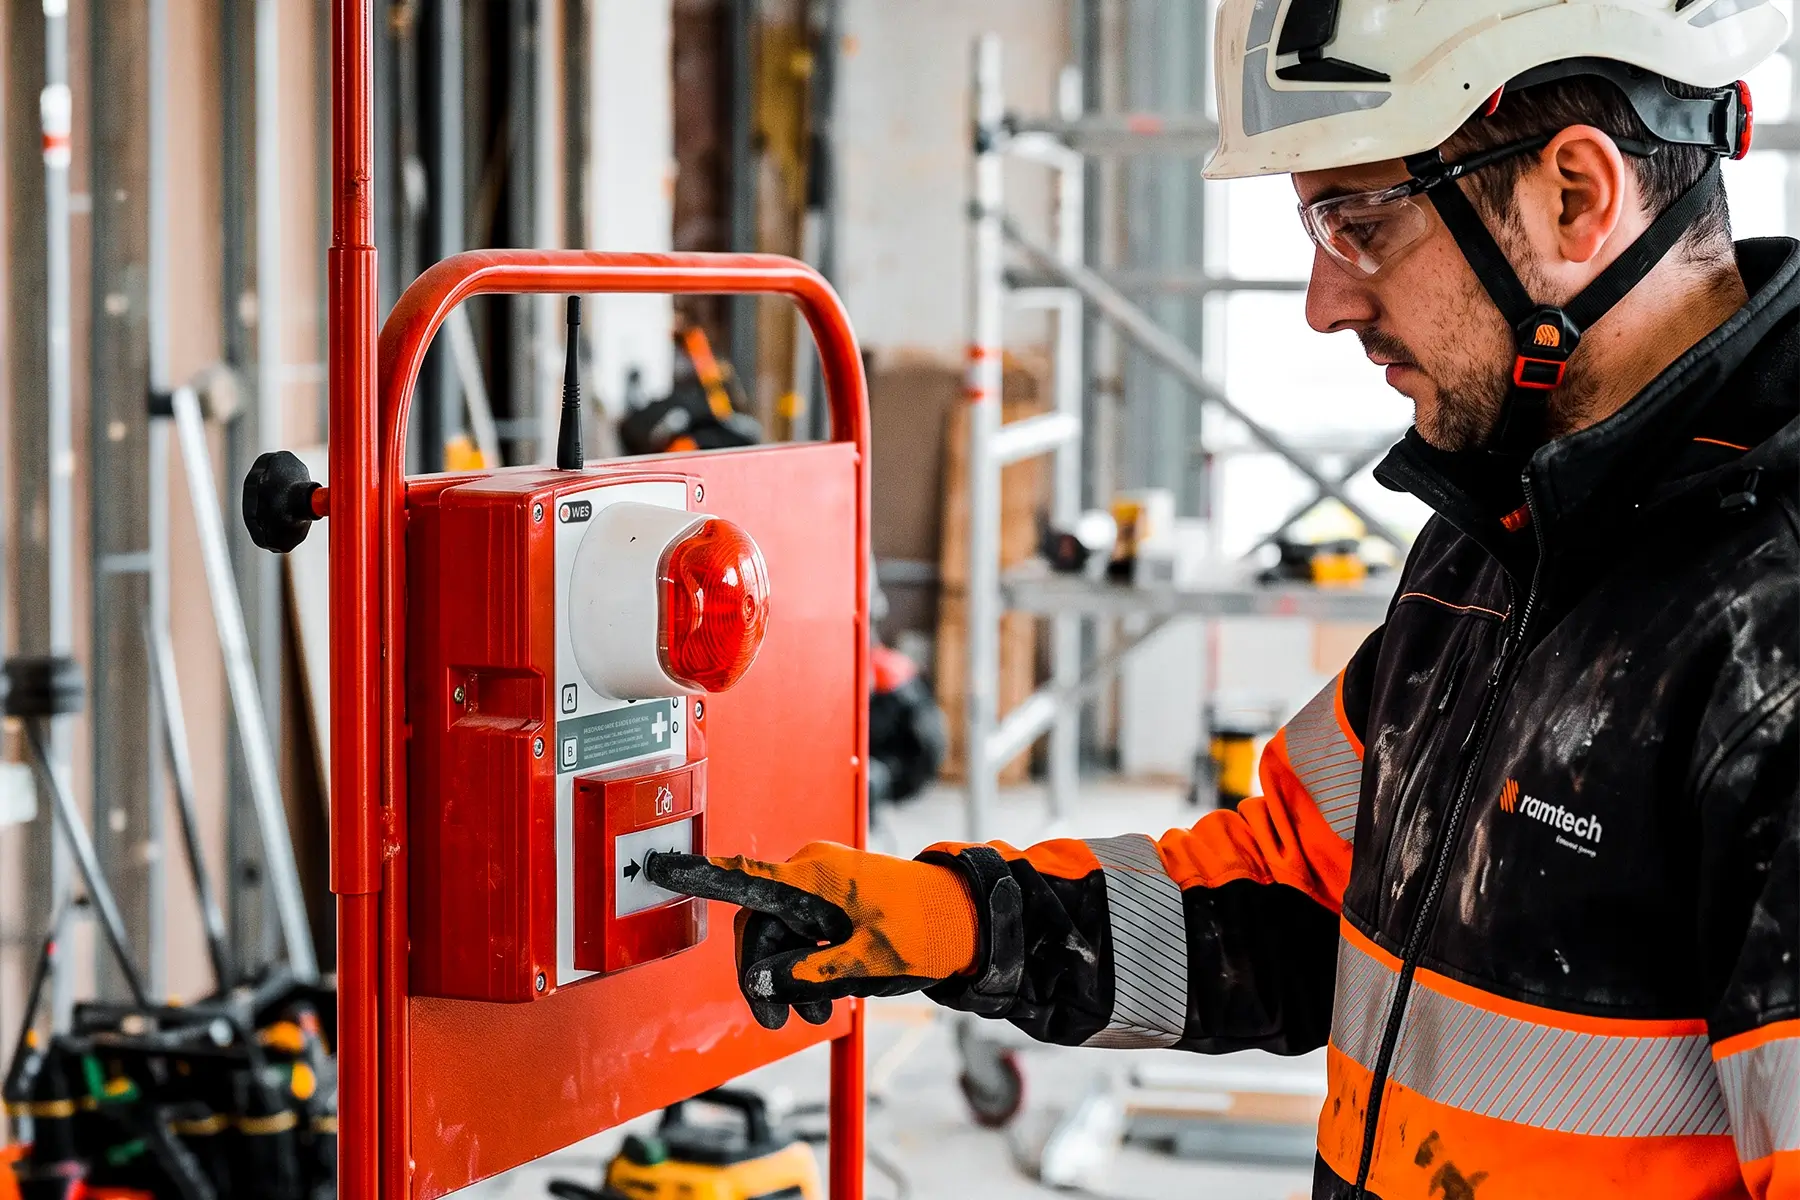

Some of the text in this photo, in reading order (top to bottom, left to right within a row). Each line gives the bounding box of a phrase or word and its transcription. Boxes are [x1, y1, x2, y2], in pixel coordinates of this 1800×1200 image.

[571, 505, 590, 518] WES
[567, 693, 573, 704] A
[567, 746, 573, 757] B
[1519, 794, 1602, 843] ramtech
